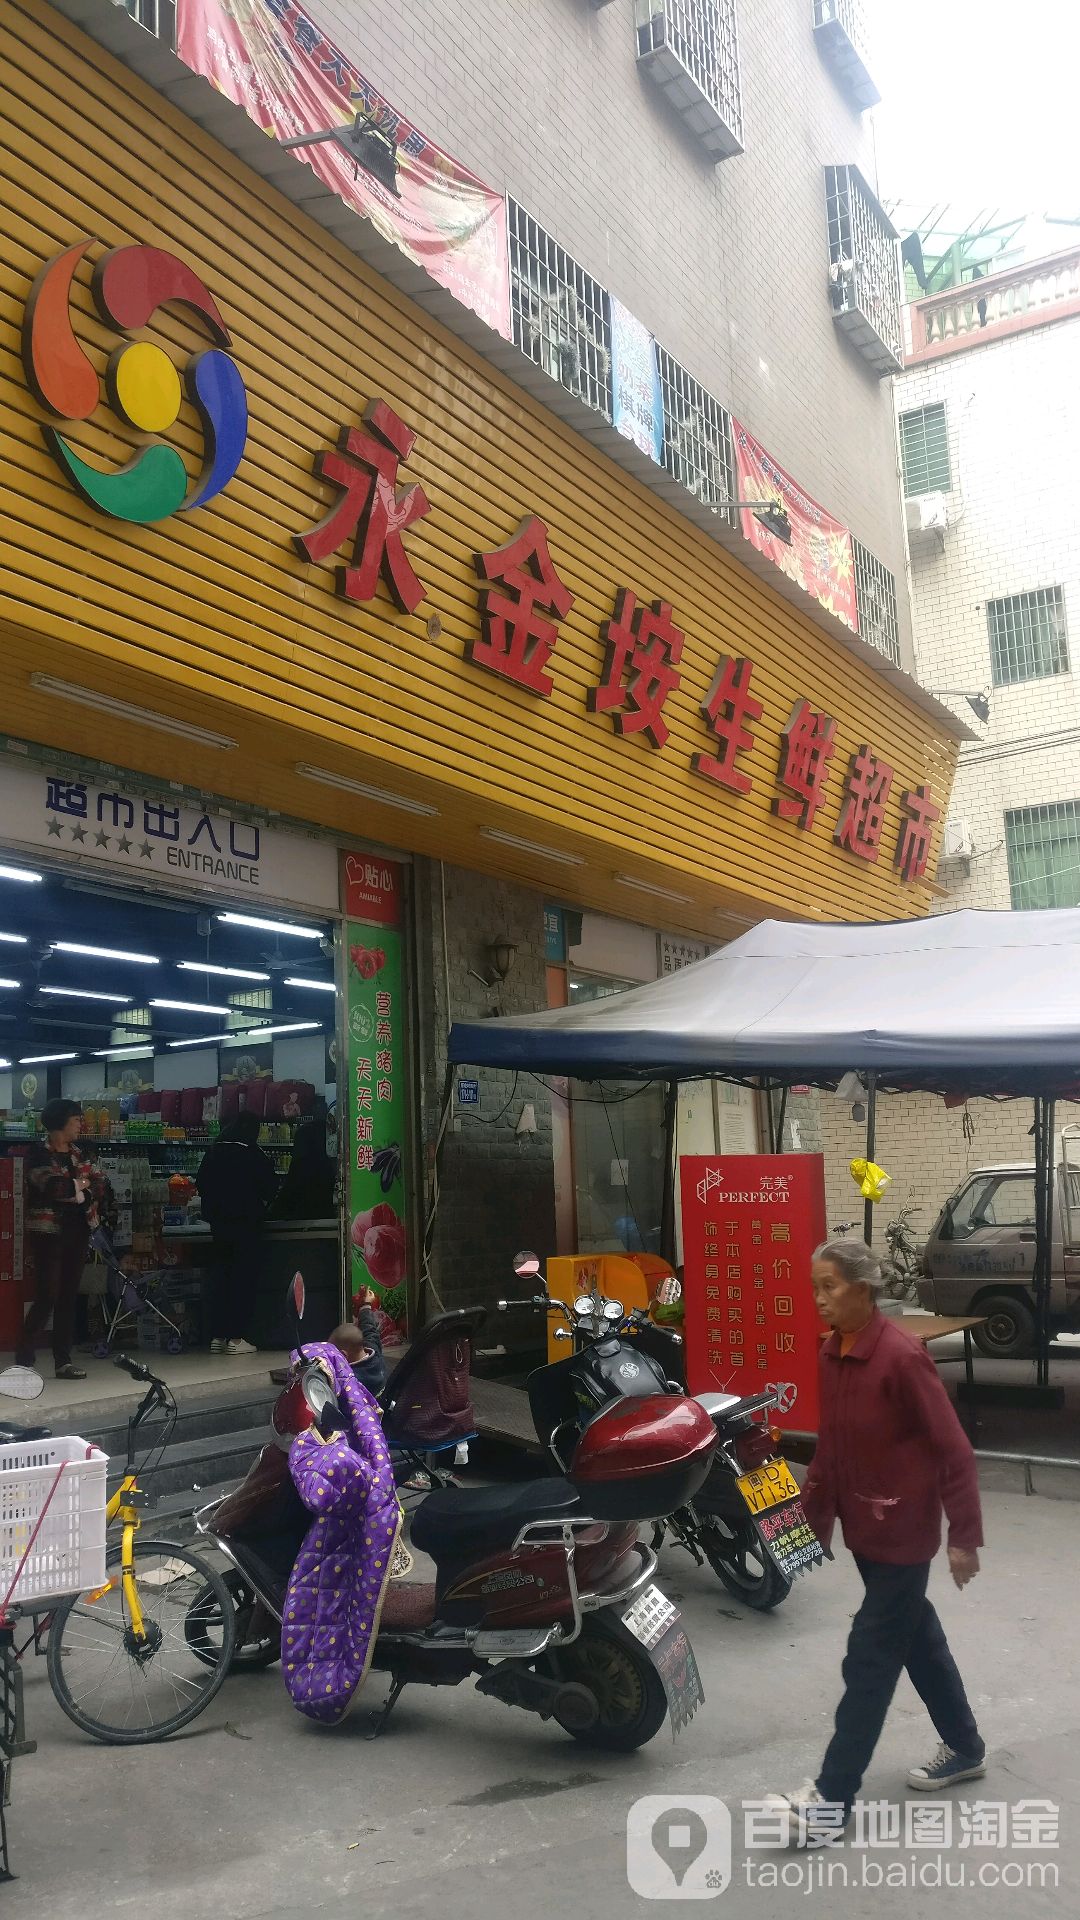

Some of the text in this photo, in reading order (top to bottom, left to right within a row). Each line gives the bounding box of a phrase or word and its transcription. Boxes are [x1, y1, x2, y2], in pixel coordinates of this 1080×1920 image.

[617, 384, 654, 433] 棋牌
[45, 776, 260, 861] 超市出入口
[166, 846, 260, 885] ENTRANCE
[364, 863, 394, 892] 贴心
[375, 990, 393, 1102] 营养猪肉
[356, 1057, 374, 1170] 天天新鲜
[718, 1191, 790, 1203] PERFECT
[759, 1176, 789, 1191] 完美
[704, 1221, 723, 1366] 饰终身免费清洗
[724, 1221, 744, 1367] 于本店购买的首
[770, 1222, 796, 1354] 高价回收
